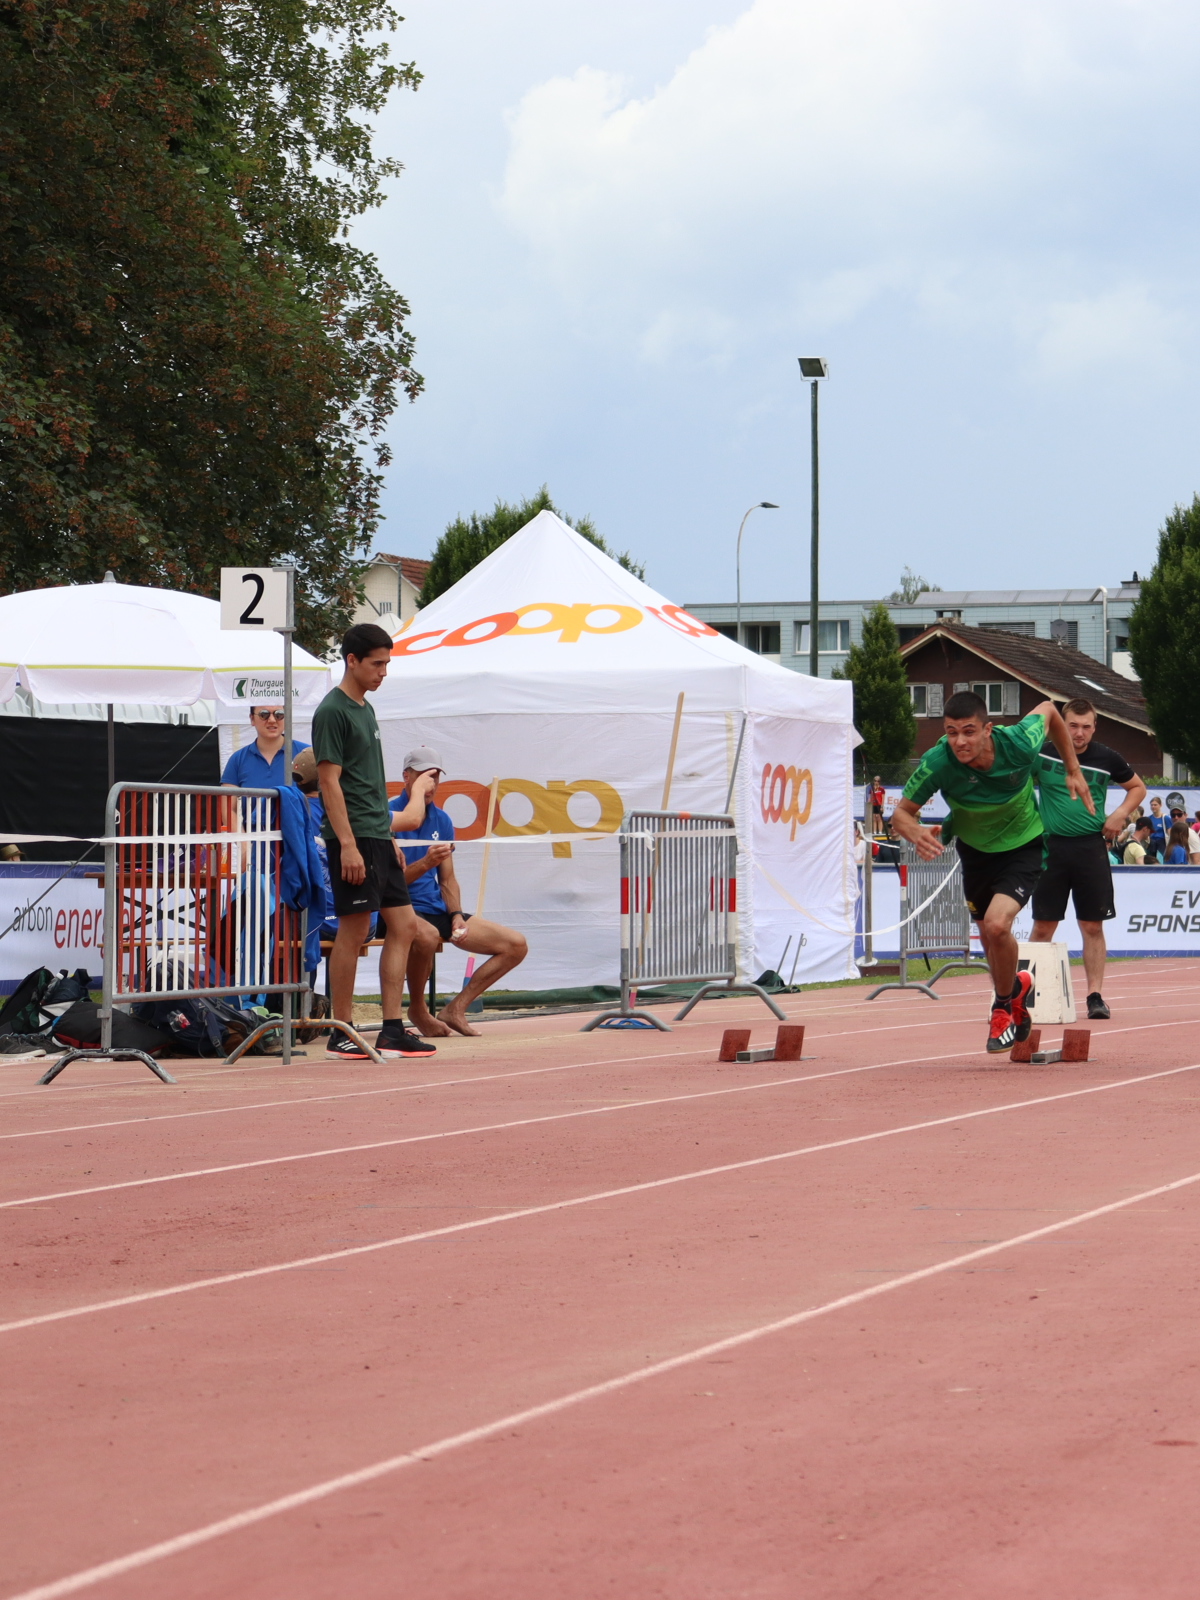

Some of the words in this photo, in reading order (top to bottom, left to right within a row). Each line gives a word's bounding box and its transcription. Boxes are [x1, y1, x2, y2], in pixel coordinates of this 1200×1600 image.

[240, 573, 265, 624] 2
[390, 602, 643, 656] coop
[250, 688, 300, 697] Kantonalbnk
[251, 679, 284, 689] Thurgaue
[386, 778, 624, 858] oop
[761, 763, 813, 841] coop
[12, 898, 53, 932] arbon
